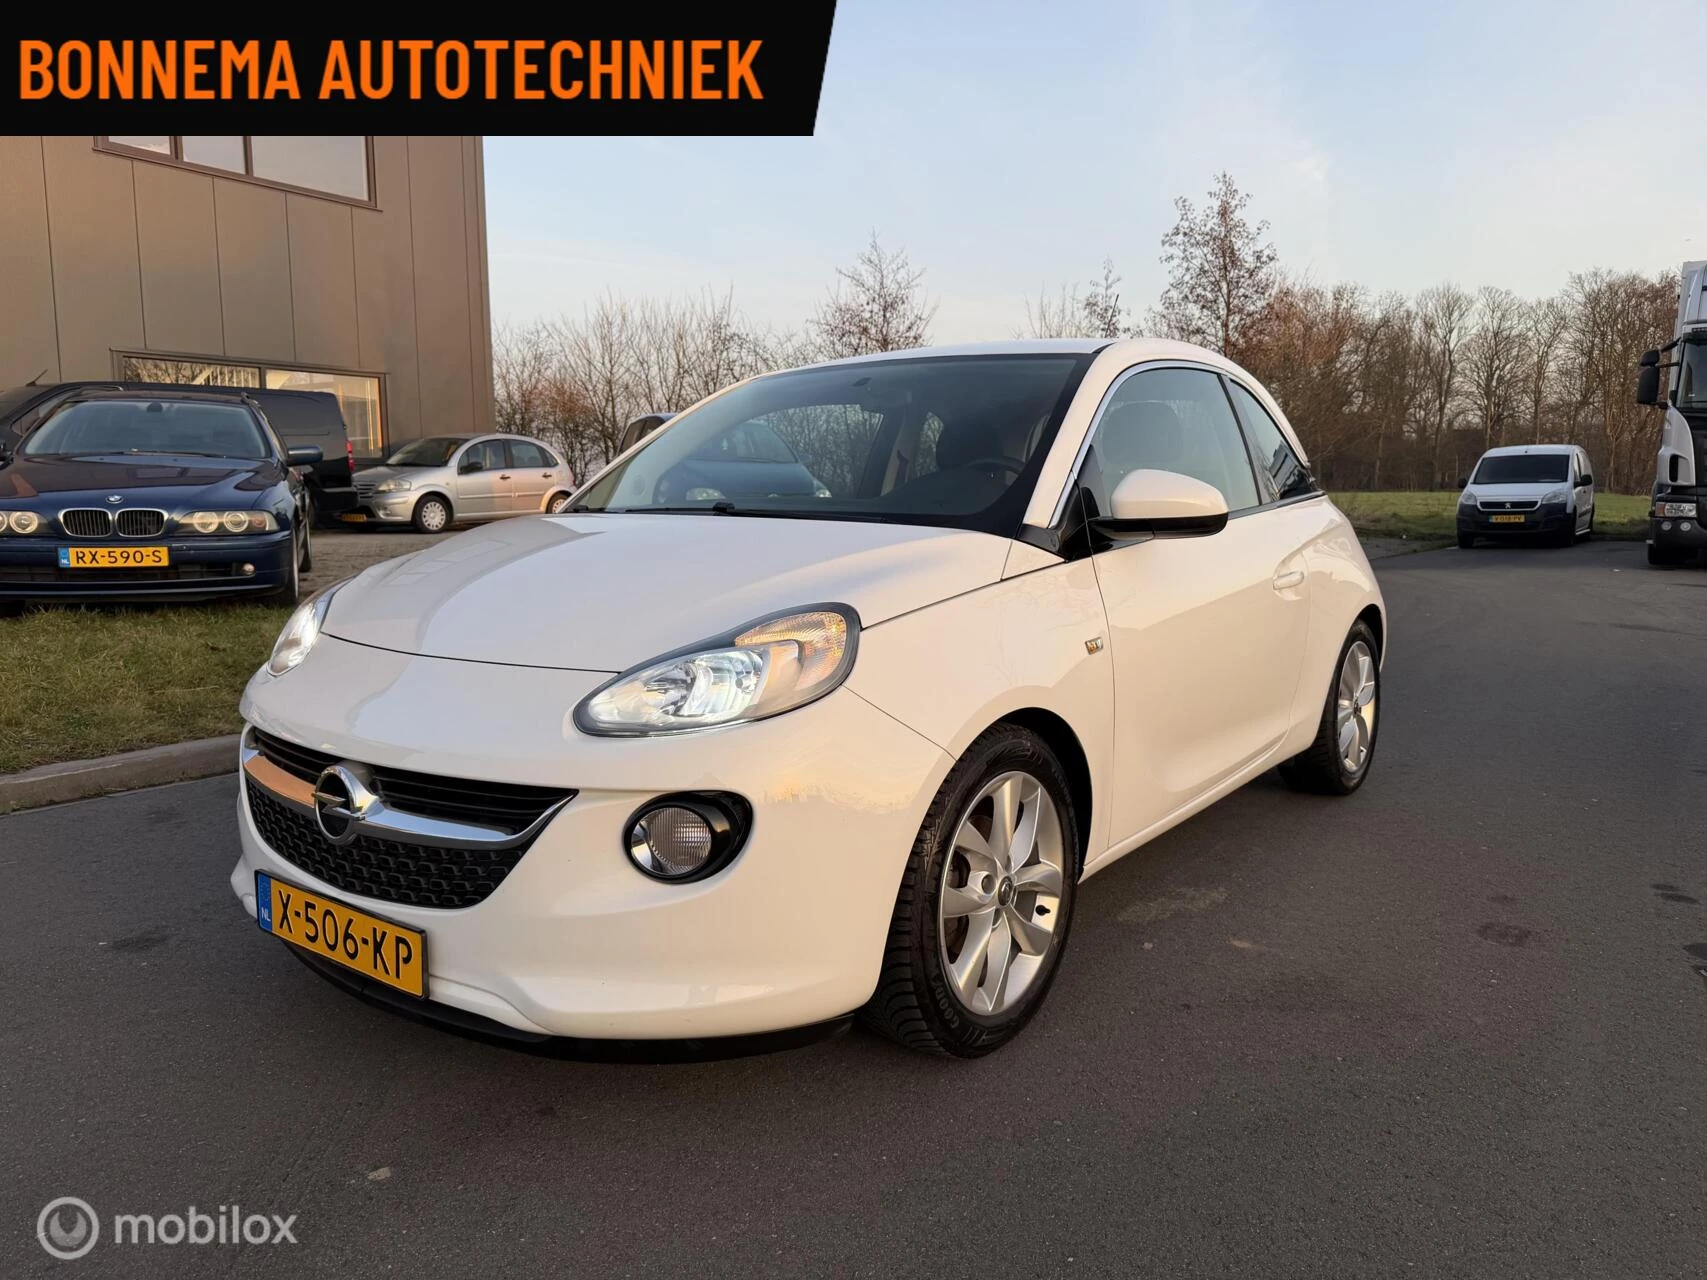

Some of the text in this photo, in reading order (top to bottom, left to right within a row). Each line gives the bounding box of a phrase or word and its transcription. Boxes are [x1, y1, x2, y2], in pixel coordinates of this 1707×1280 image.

[75, 550, 162, 564] RX-590-S
[261, 889, 413, 979] NL X-506-KP
